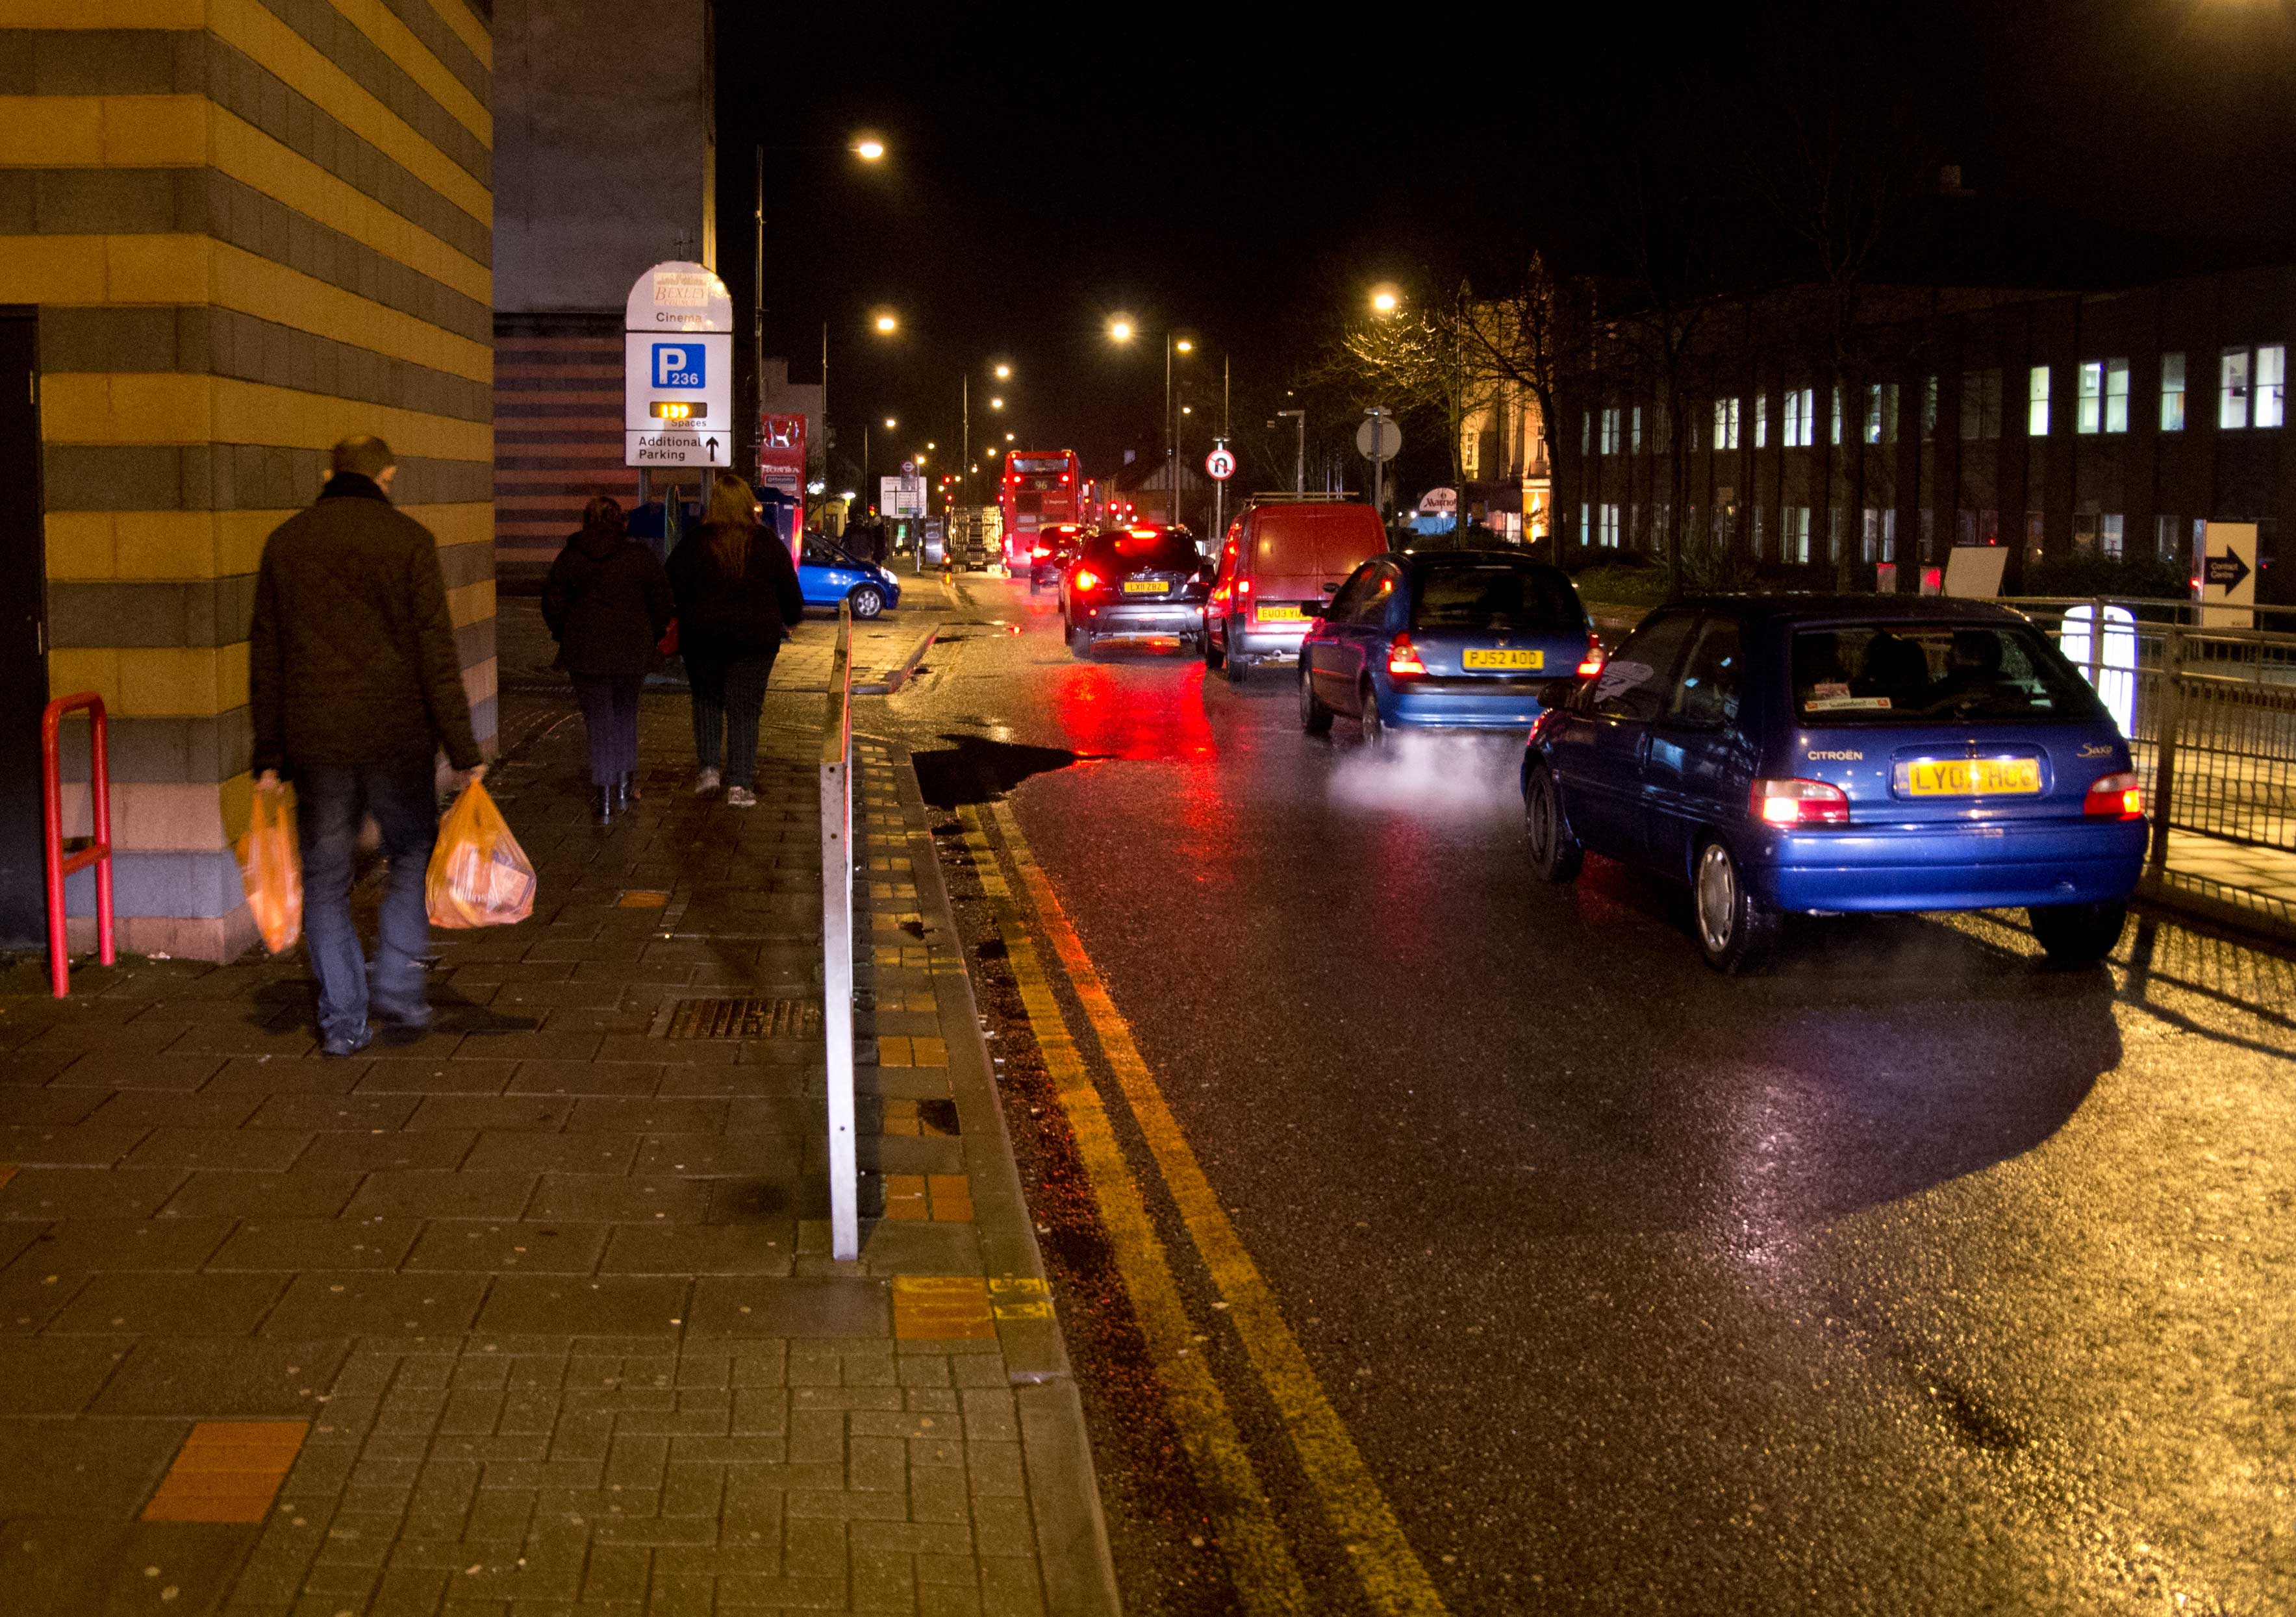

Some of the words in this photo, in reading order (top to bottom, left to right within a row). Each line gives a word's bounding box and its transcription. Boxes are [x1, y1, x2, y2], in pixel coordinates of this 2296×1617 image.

[656, 312, 702, 323] Cinema
[659, 348, 687, 384] P
[672, 373, 698, 384] 236
[671, 419, 707, 427] Spaces
[639, 436, 701, 447] Additional
[639, 449, 685, 462] Parking
[1470, 651, 1507, 665] PJ52
[1808, 749, 1863, 761] CITROËN
[1916, 766, 1981, 790] LY0
